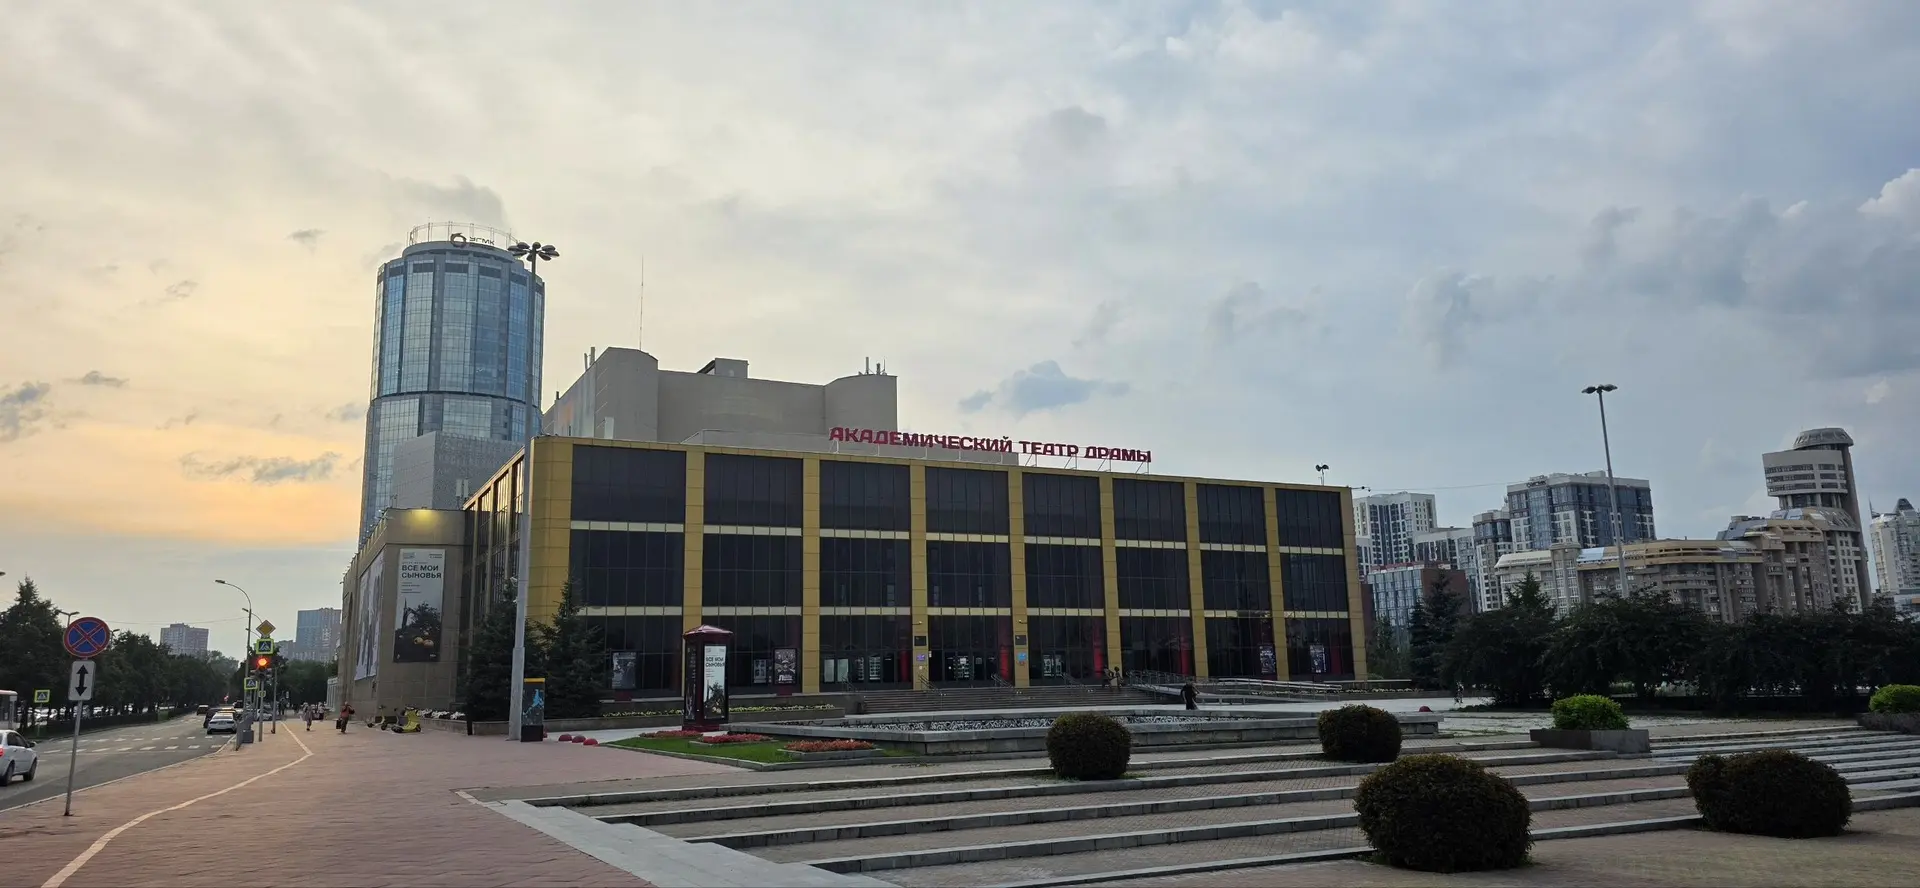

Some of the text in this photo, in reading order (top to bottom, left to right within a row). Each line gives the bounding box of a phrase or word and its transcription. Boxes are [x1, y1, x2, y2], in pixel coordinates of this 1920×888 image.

[829, 426, 1152, 463] АКАДЕМИЧЕСКИЙ ТЕАТР ДРАМЫ
